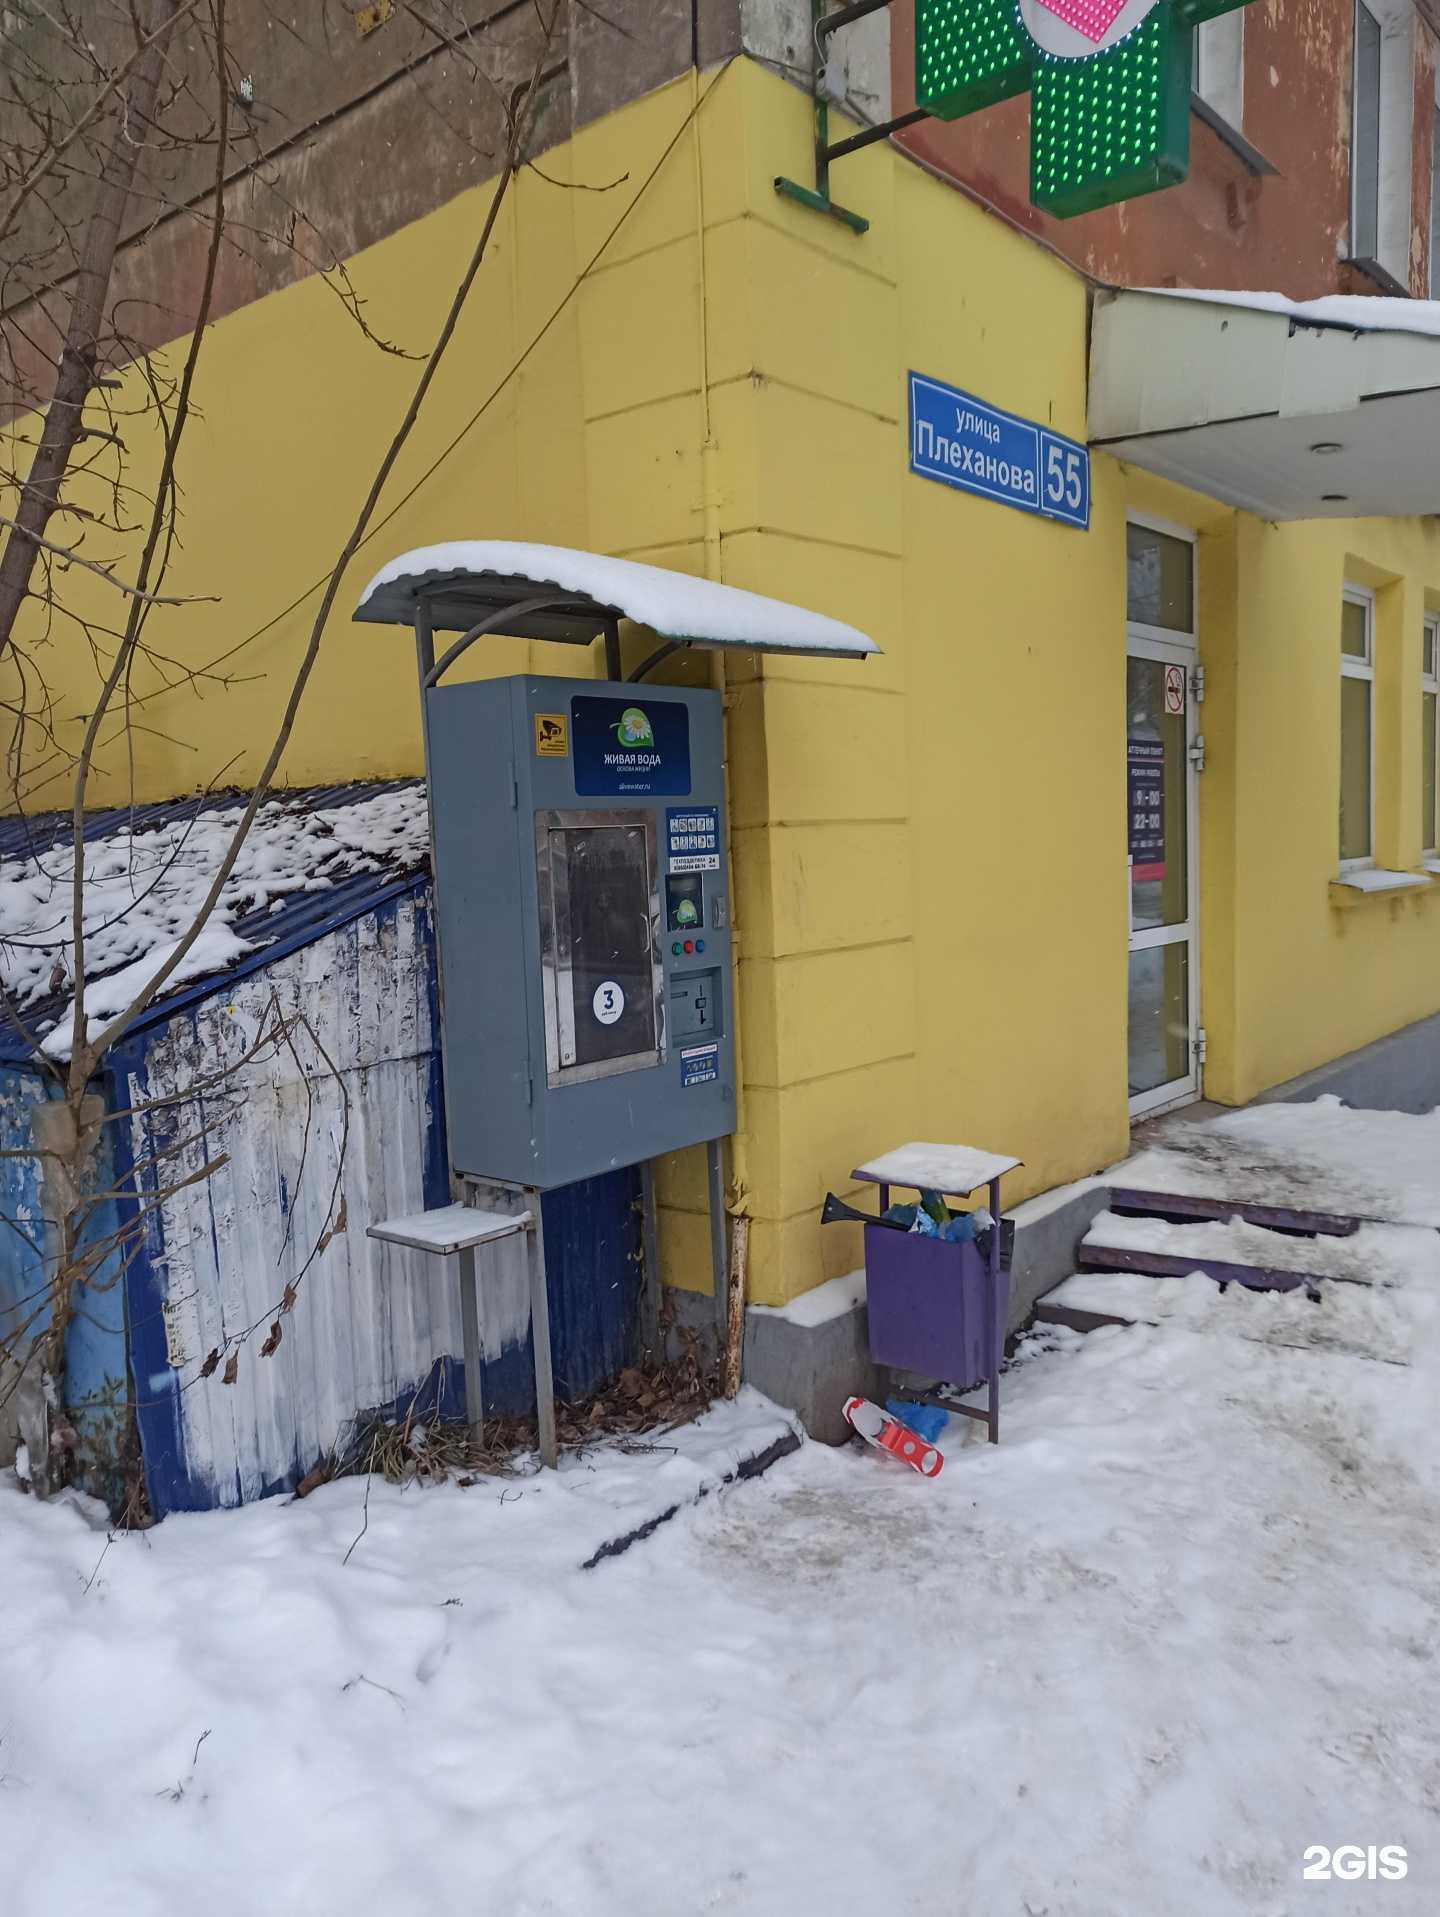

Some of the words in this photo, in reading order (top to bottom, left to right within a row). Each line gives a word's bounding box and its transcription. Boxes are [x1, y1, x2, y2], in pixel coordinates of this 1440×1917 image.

[956, 408, 1000, 444] улица
[917, 420, 1035, 494] Плеханова
[1047, 445, 1082, 509] 55
[604, 753, 636, 765] ЖИВАЯ
[637, 754, 662, 767] ВОДА
[603, 990, 614, 1009] 3
